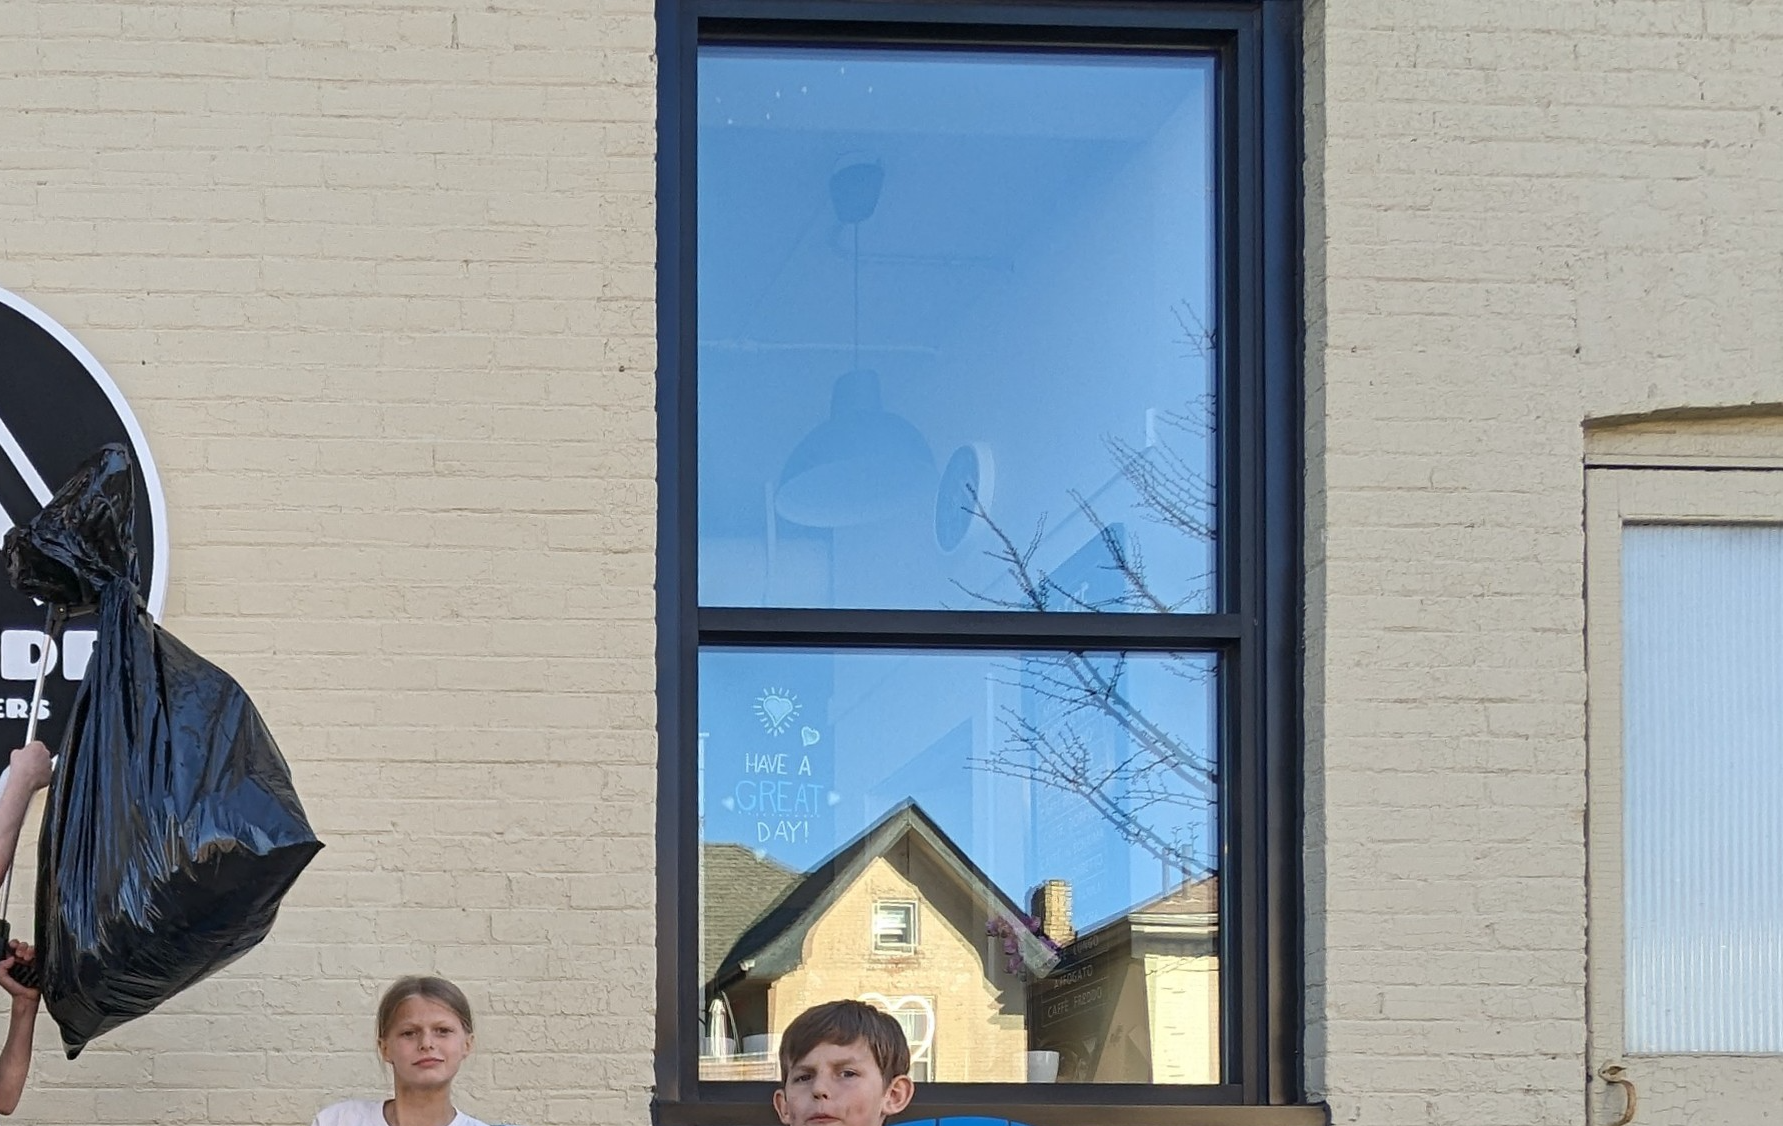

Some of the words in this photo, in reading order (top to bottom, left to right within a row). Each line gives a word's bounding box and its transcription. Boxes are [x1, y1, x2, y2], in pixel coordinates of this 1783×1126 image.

[745, 753, 788, 774] HAVE
[798, 755, 811, 776] A
[736, 780, 824, 815] GREAT
[757, 820, 808, 844] DAY!
